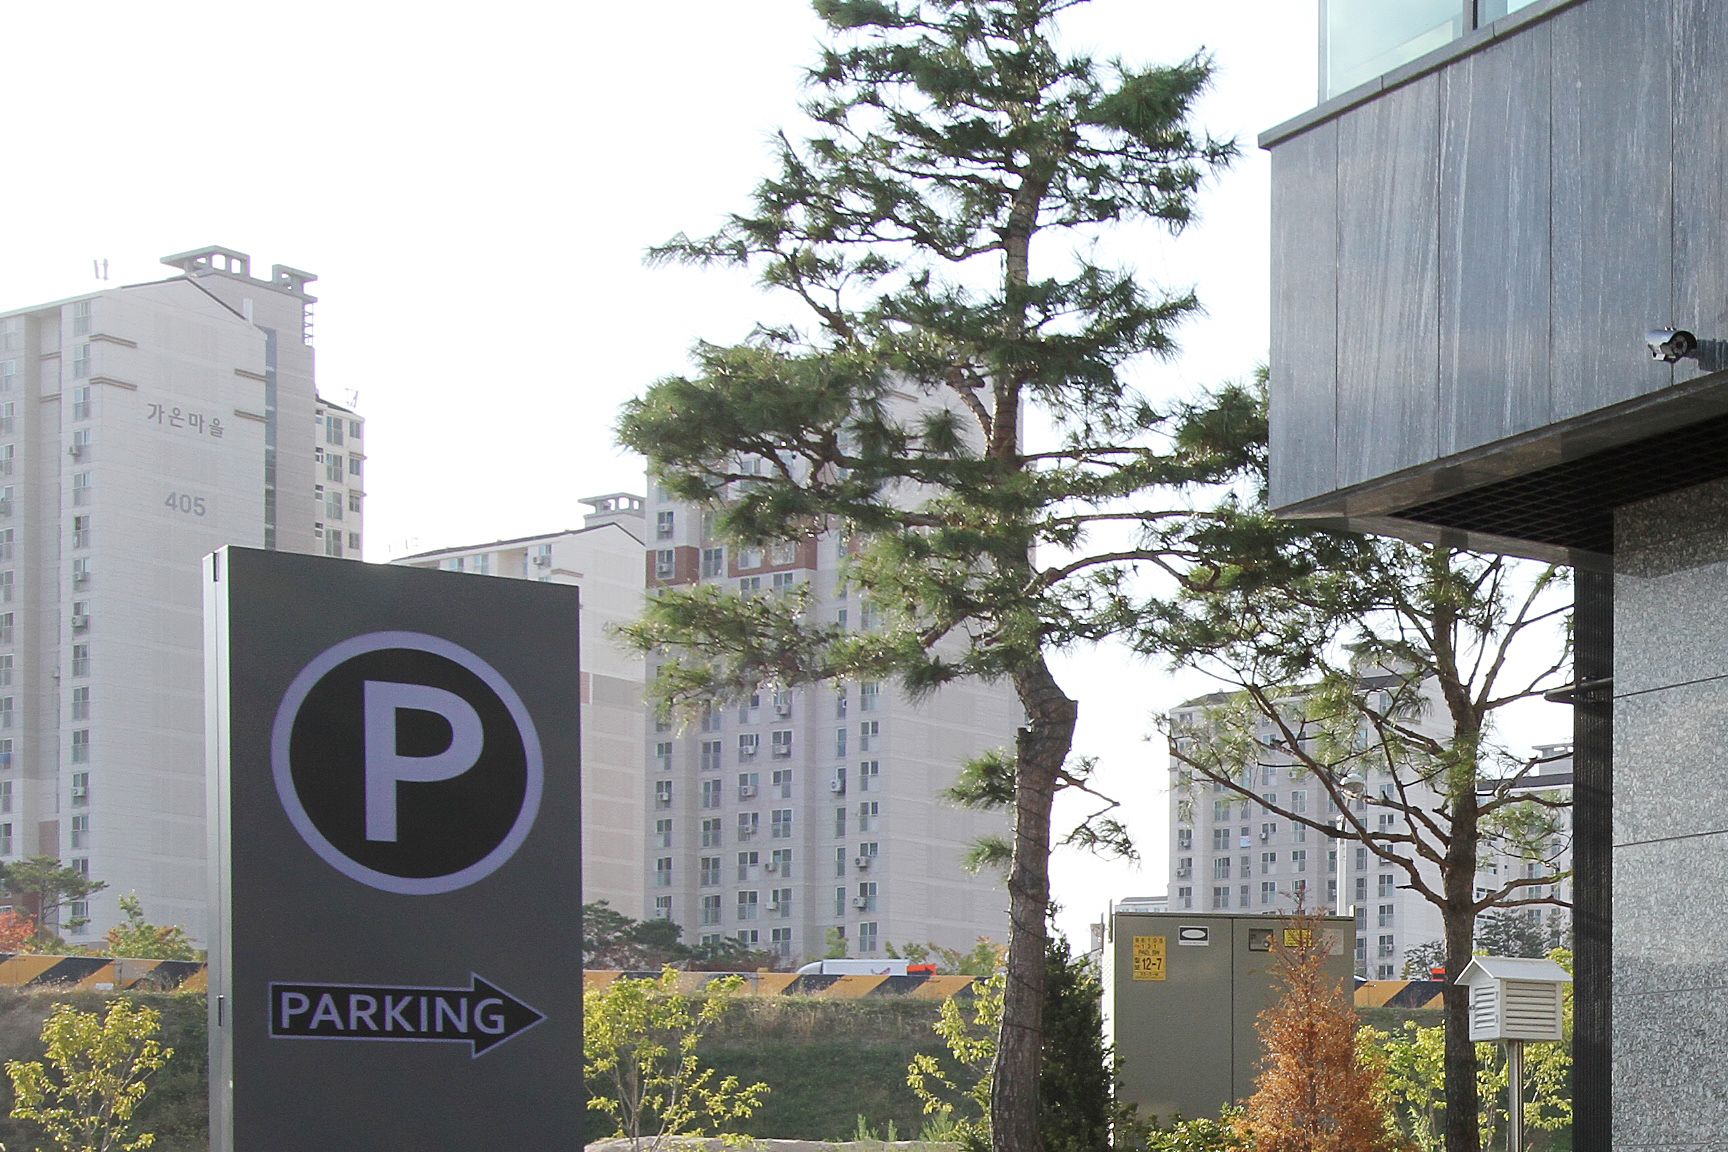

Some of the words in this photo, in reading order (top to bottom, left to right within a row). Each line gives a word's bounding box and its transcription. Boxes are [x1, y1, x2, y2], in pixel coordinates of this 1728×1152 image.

[147, 403, 225, 439] 가온마을
[165, 491, 207, 517] 405
[1142, 957, 1162, 970] 12-7
[280, 991, 506, 1036] PARKING
